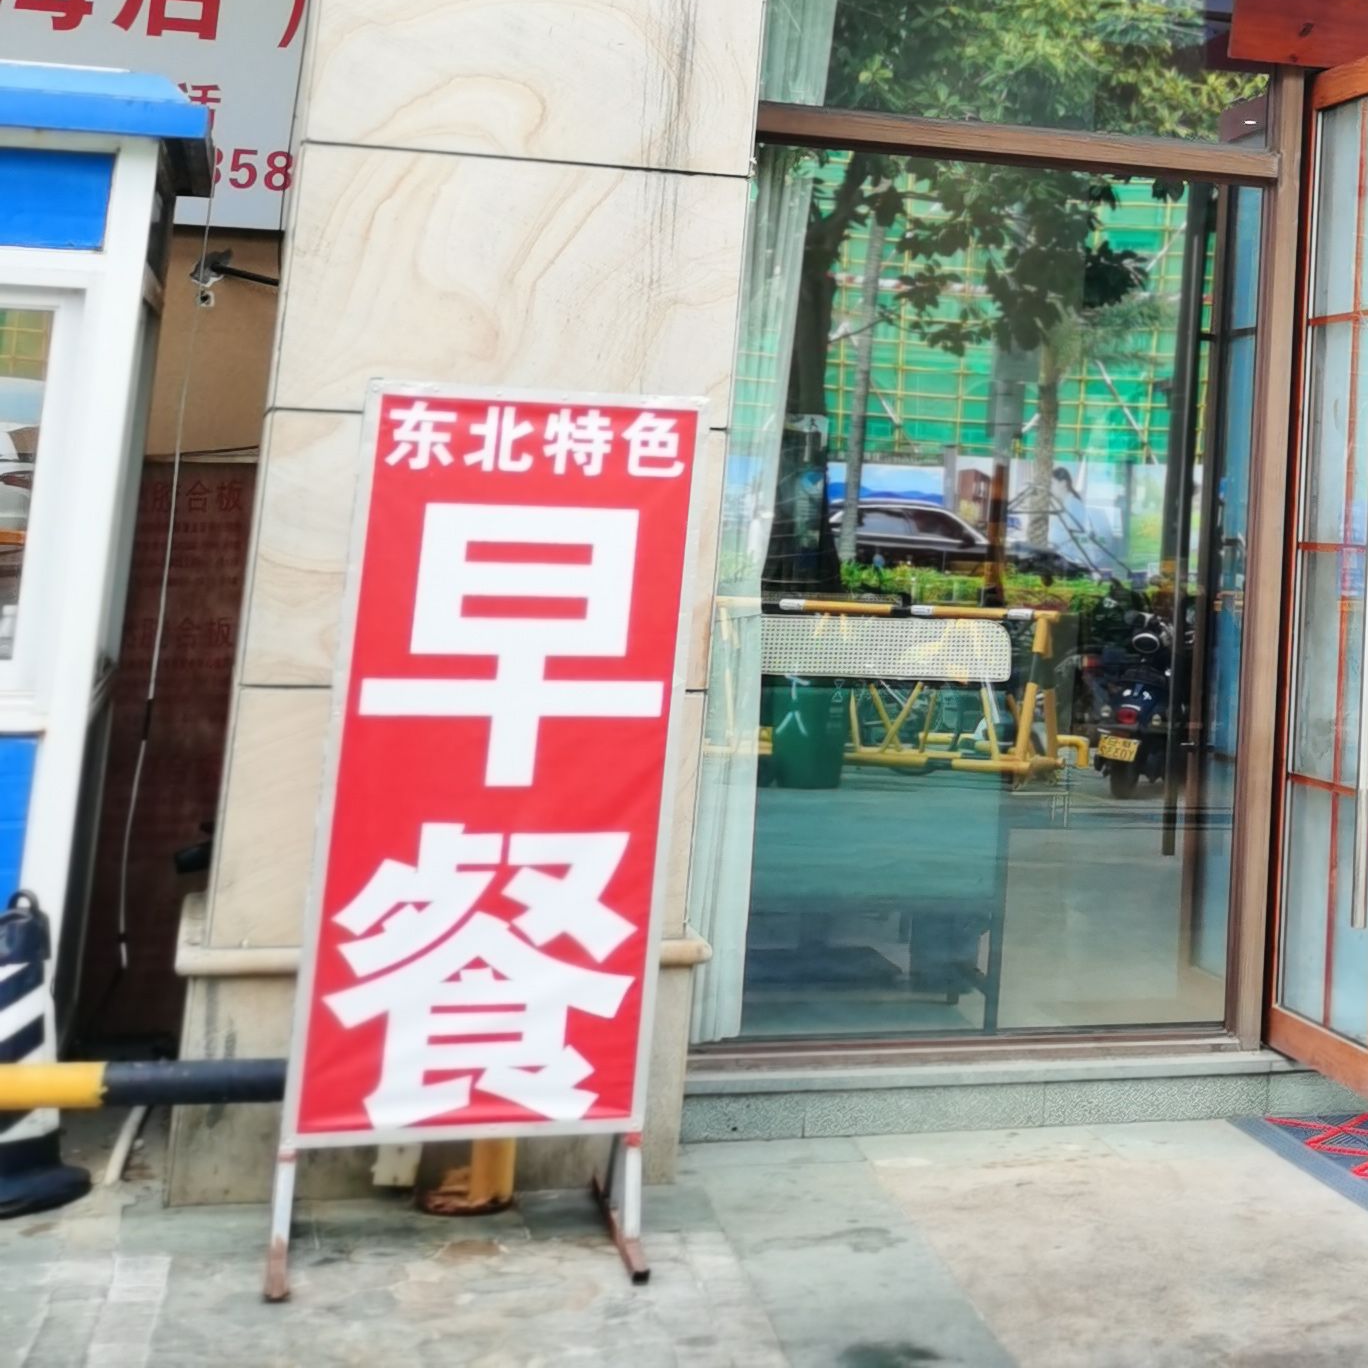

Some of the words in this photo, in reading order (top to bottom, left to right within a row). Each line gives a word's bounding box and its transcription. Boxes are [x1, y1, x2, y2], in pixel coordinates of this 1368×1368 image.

[384, 399, 686, 479] 东北特色
[322, 501, 664, 1129] 早餐
